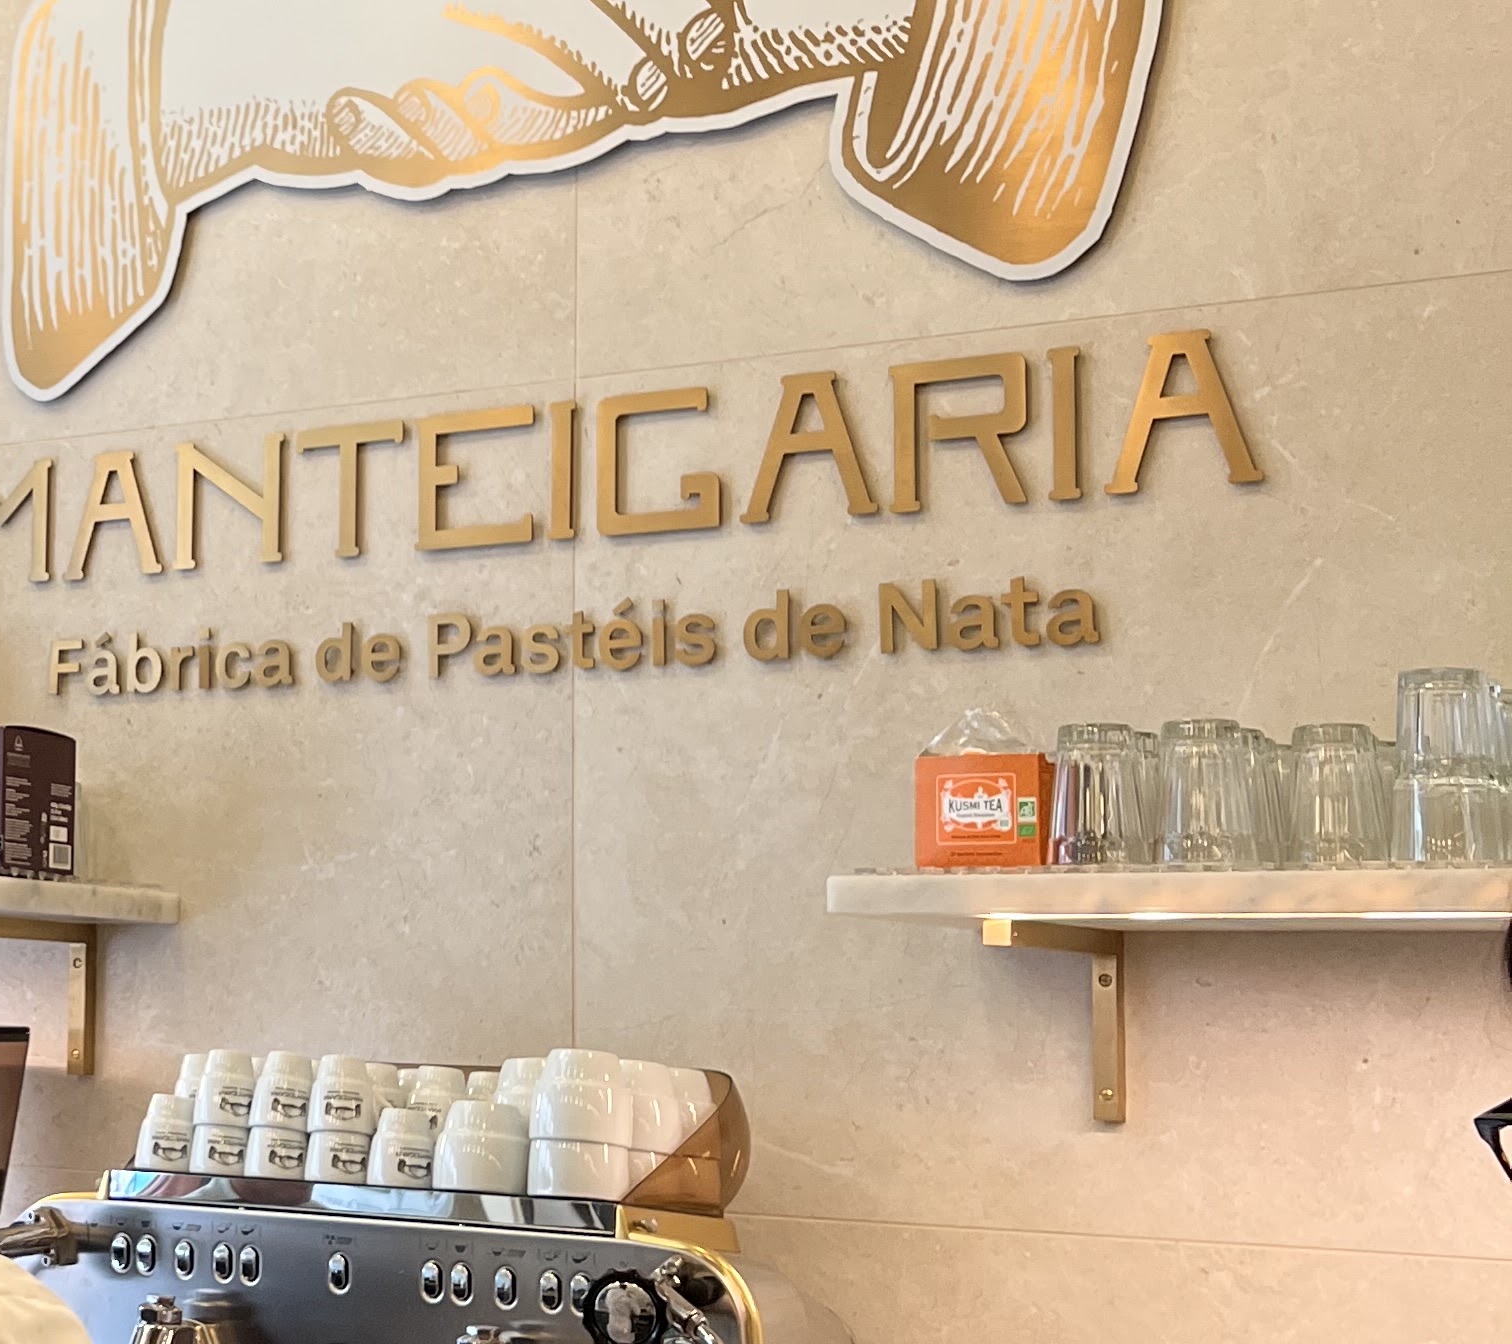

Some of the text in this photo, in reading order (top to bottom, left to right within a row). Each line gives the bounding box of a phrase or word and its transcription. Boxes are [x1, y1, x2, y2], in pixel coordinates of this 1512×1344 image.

[48, 575, 1101, 697] Fábrica de Pastéis de Nata
[948, 798, 1003, 814] KUSMI TEA
